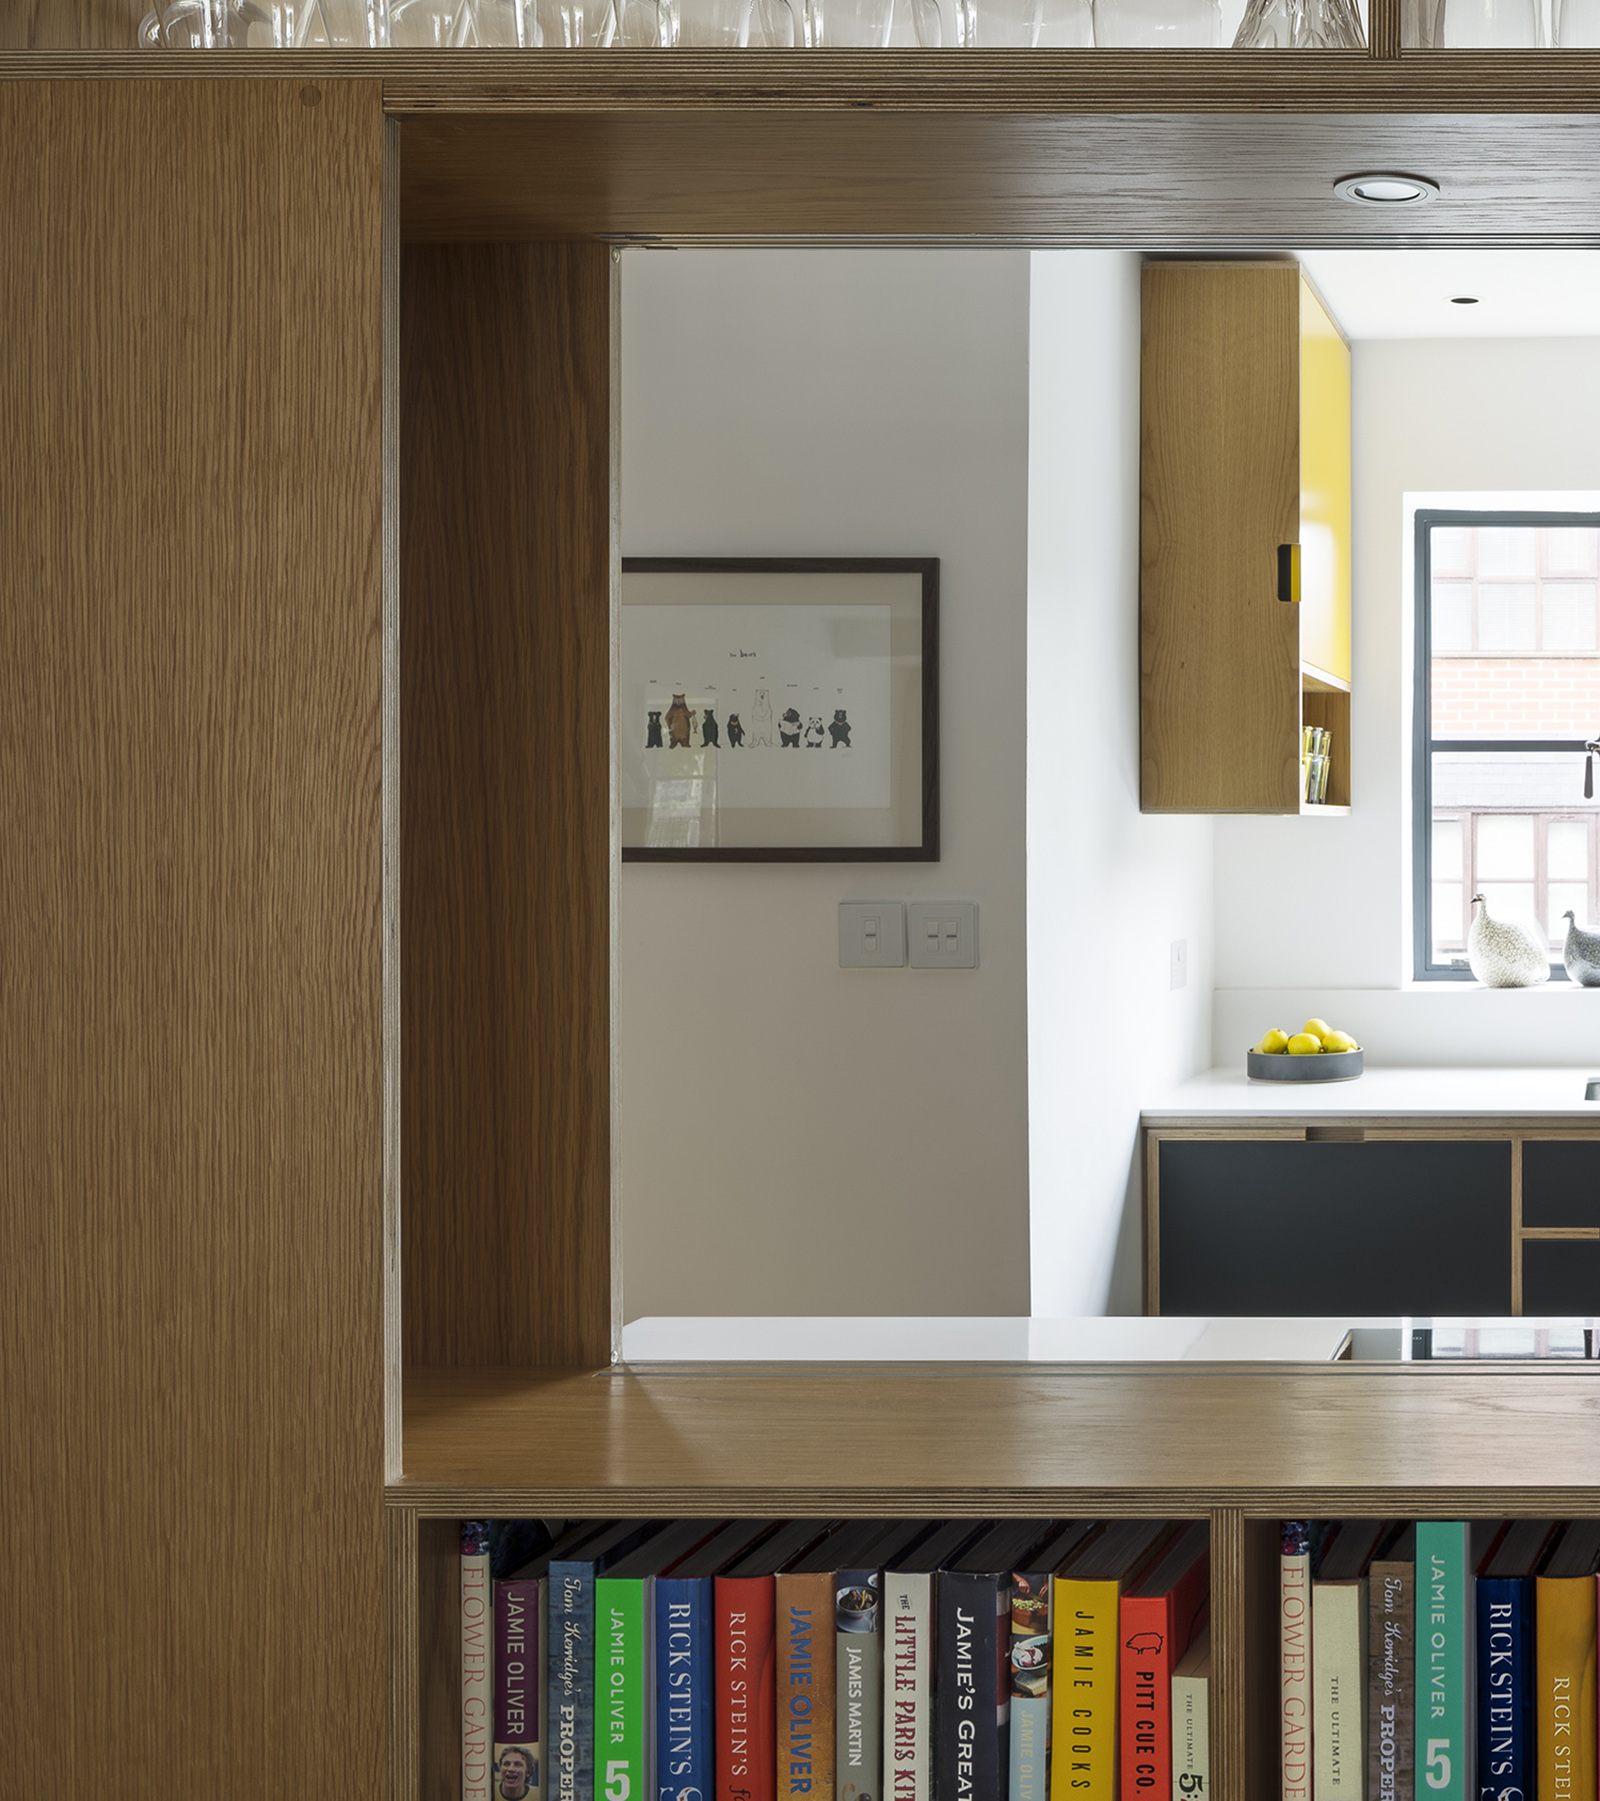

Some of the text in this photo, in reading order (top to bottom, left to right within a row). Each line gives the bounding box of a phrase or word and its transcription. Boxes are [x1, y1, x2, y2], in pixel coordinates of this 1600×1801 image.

[463, 1566, 485, 1689] FLOWER
[563, 1578, 582, 1615] Tom
[668, 1603, 691, 1667] RICK
[730, 1612, 747, 1671] RICK
[899, 1594, 910, 1610] THE
[1282, 1567, 1306, 1687] FLOWER
[1384, 1577, 1402, 1613] Tom
[1489, 1602, 1512, 1666] RICK
[506, 1592, 525, 1736] JAMIE OLIVER
[558, 1622, 583, 1696] Kerridge's
[790, 1606, 812, 1794] JAMIE OLIVER
[895, 1615, 917, 1692] LITTLE
[957, 1607, 975, 1711] JAMIE'S
[1071, 1611, 1094, 1789] JAMIE COOKS
[1379, 1621, 1402, 1697] Kerridge's
[1425, 1555, 1451, 1789] JAMIE OLIVER 5
[605, 1608, 630, 1801] JAMIE OLIVER 5
[669, 1672, 692, 1776] STEIN'S
[730, 1682, 750, 1777] STEIN'S
[847, 1647, 862, 1767] JAMES MARTIN
[894, 1699, 916, 1762] PARIS
[1020, 1710, 1034, 1759] JAMIE
[1135, 1671, 1156, 1795] PITT CUE CO.
[1185, 1694, 1193, 1715] THE
[1185, 1717, 1194, 1770] ULTIMATE
[1331, 1677, 1341, 1785] THE ULTIMATE
[1490, 1673, 1513, 1775] STEIN'S
[1553, 1677, 1571, 1798] RICK STEI
